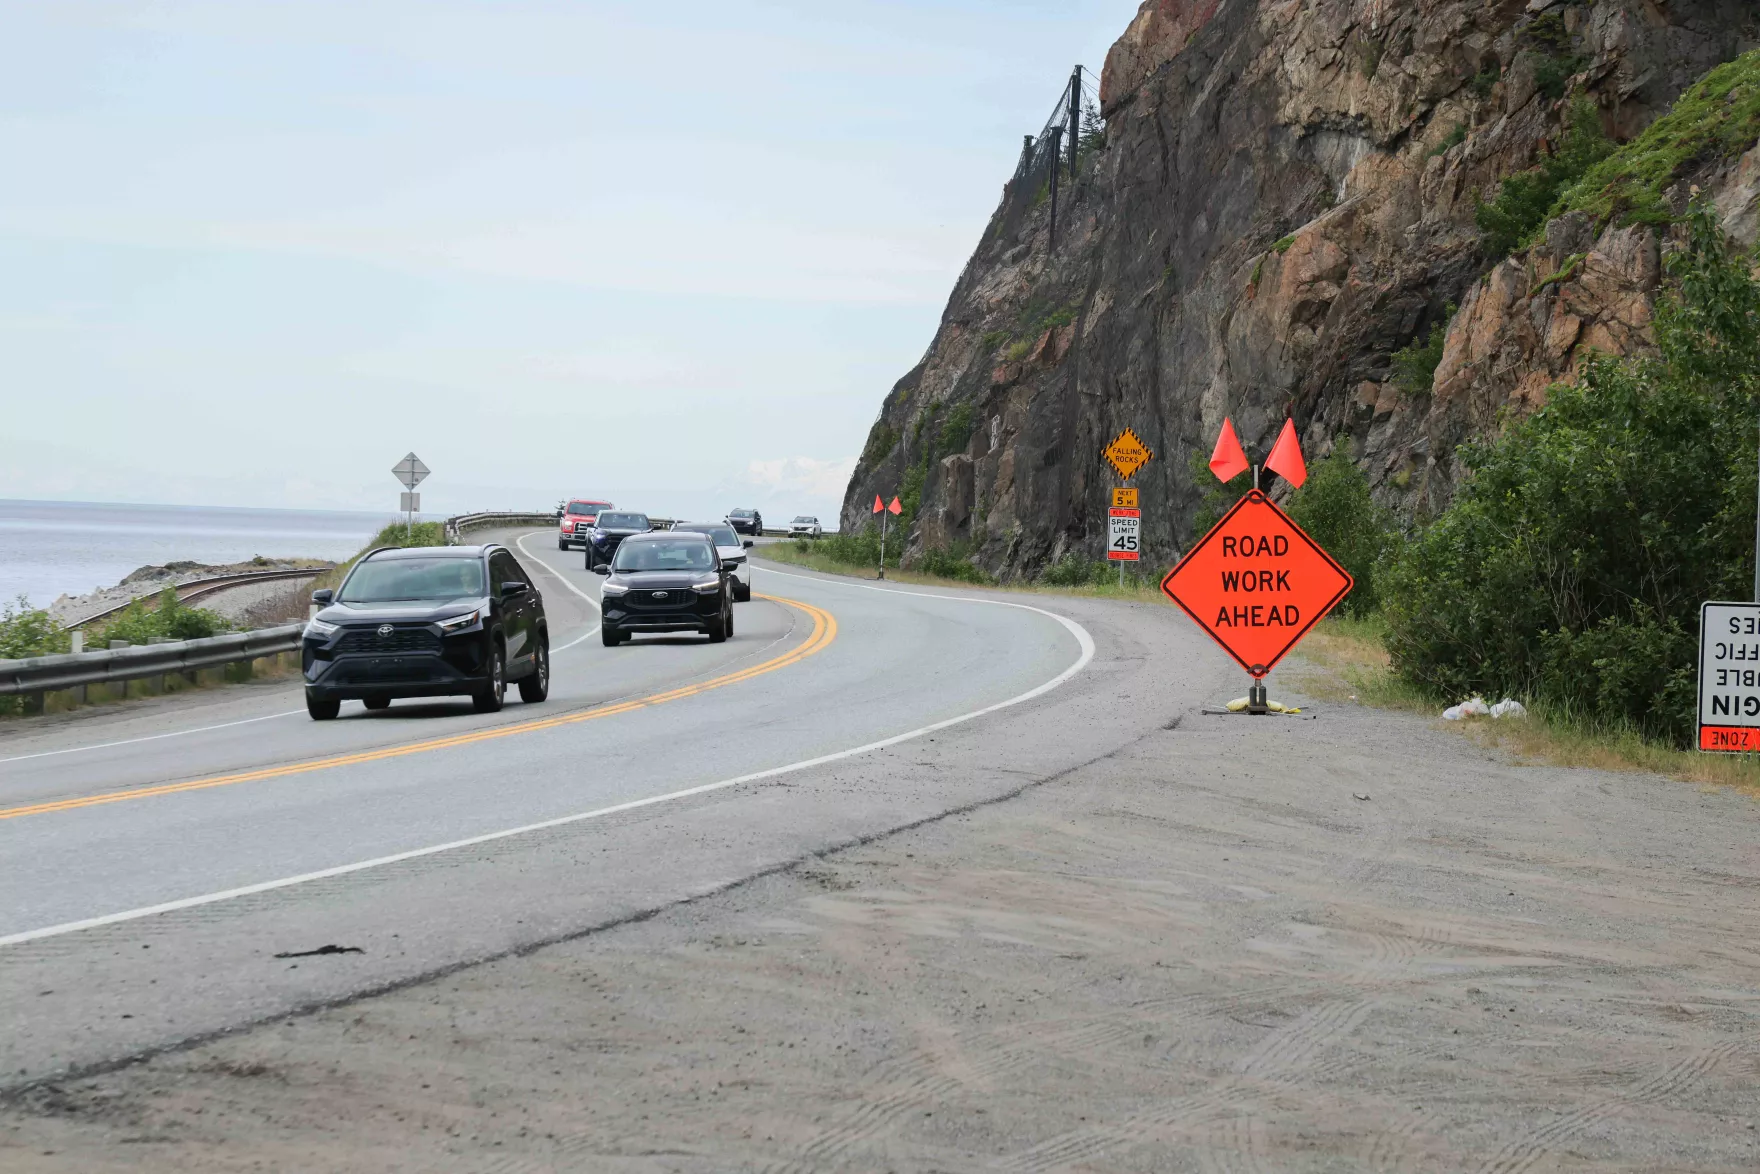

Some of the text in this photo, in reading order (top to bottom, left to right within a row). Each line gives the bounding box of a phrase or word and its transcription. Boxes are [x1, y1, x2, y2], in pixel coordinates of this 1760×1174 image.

[1112, 447, 1142, 456] FALLING
[1115, 455, 1139, 464] ROCKS
[1117, 496, 1124, 505] 5
[1111, 518, 1138, 527] SPEED
[1113, 526, 1135, 534] LIMIT
[1113, 535, 1138, 551] 45
[1222, 535, 1289, 557] ROAD
[1221, 570, 1291, 592] WORK
[1215, 605, 1300, 627] AHEAD
[1729, 616, 1760, 635] ES
[1715, 642, 1759, 661] FFIC
[1716, 668, 1760, 687] BLE
[1711, 731, 1749, 746] ZONE
